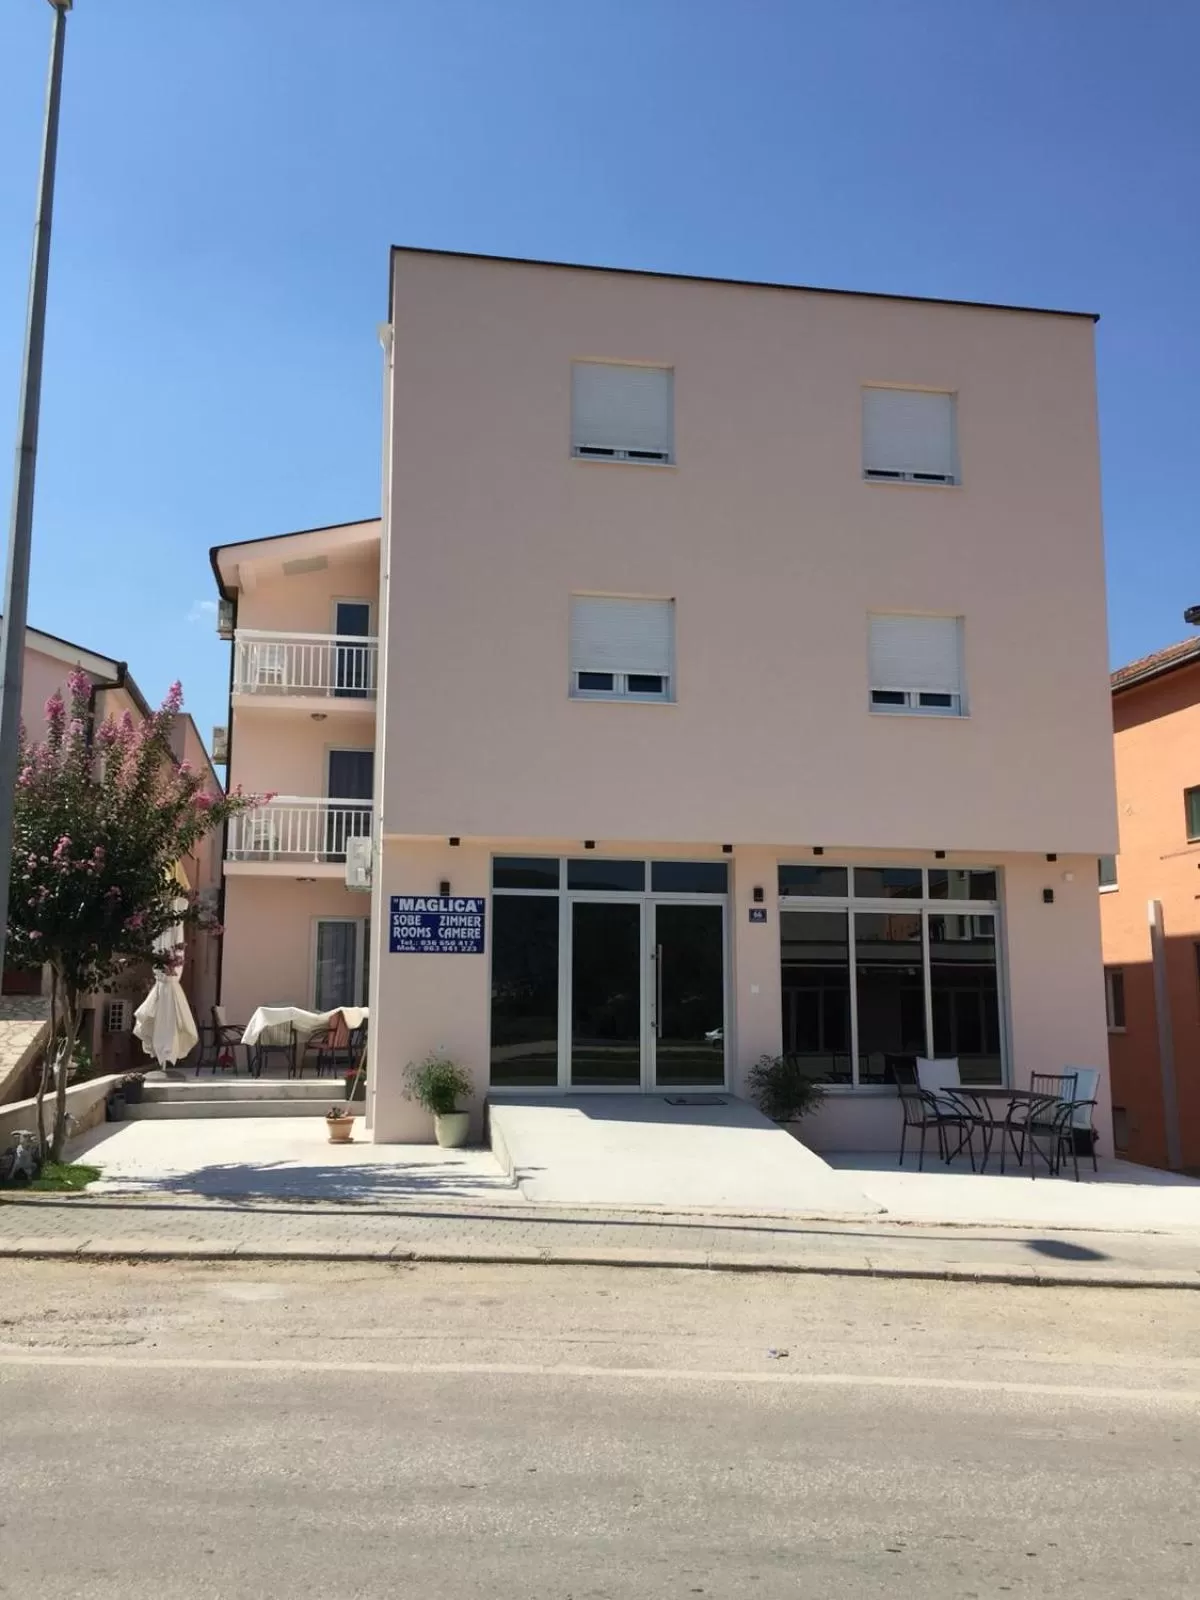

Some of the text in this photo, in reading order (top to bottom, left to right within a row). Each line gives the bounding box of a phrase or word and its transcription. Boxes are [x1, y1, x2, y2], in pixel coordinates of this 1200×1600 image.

[393, 915, 481, 927] SOBE ZIMMER
[393, 927, 481, 939] ROOMS CAMERE
